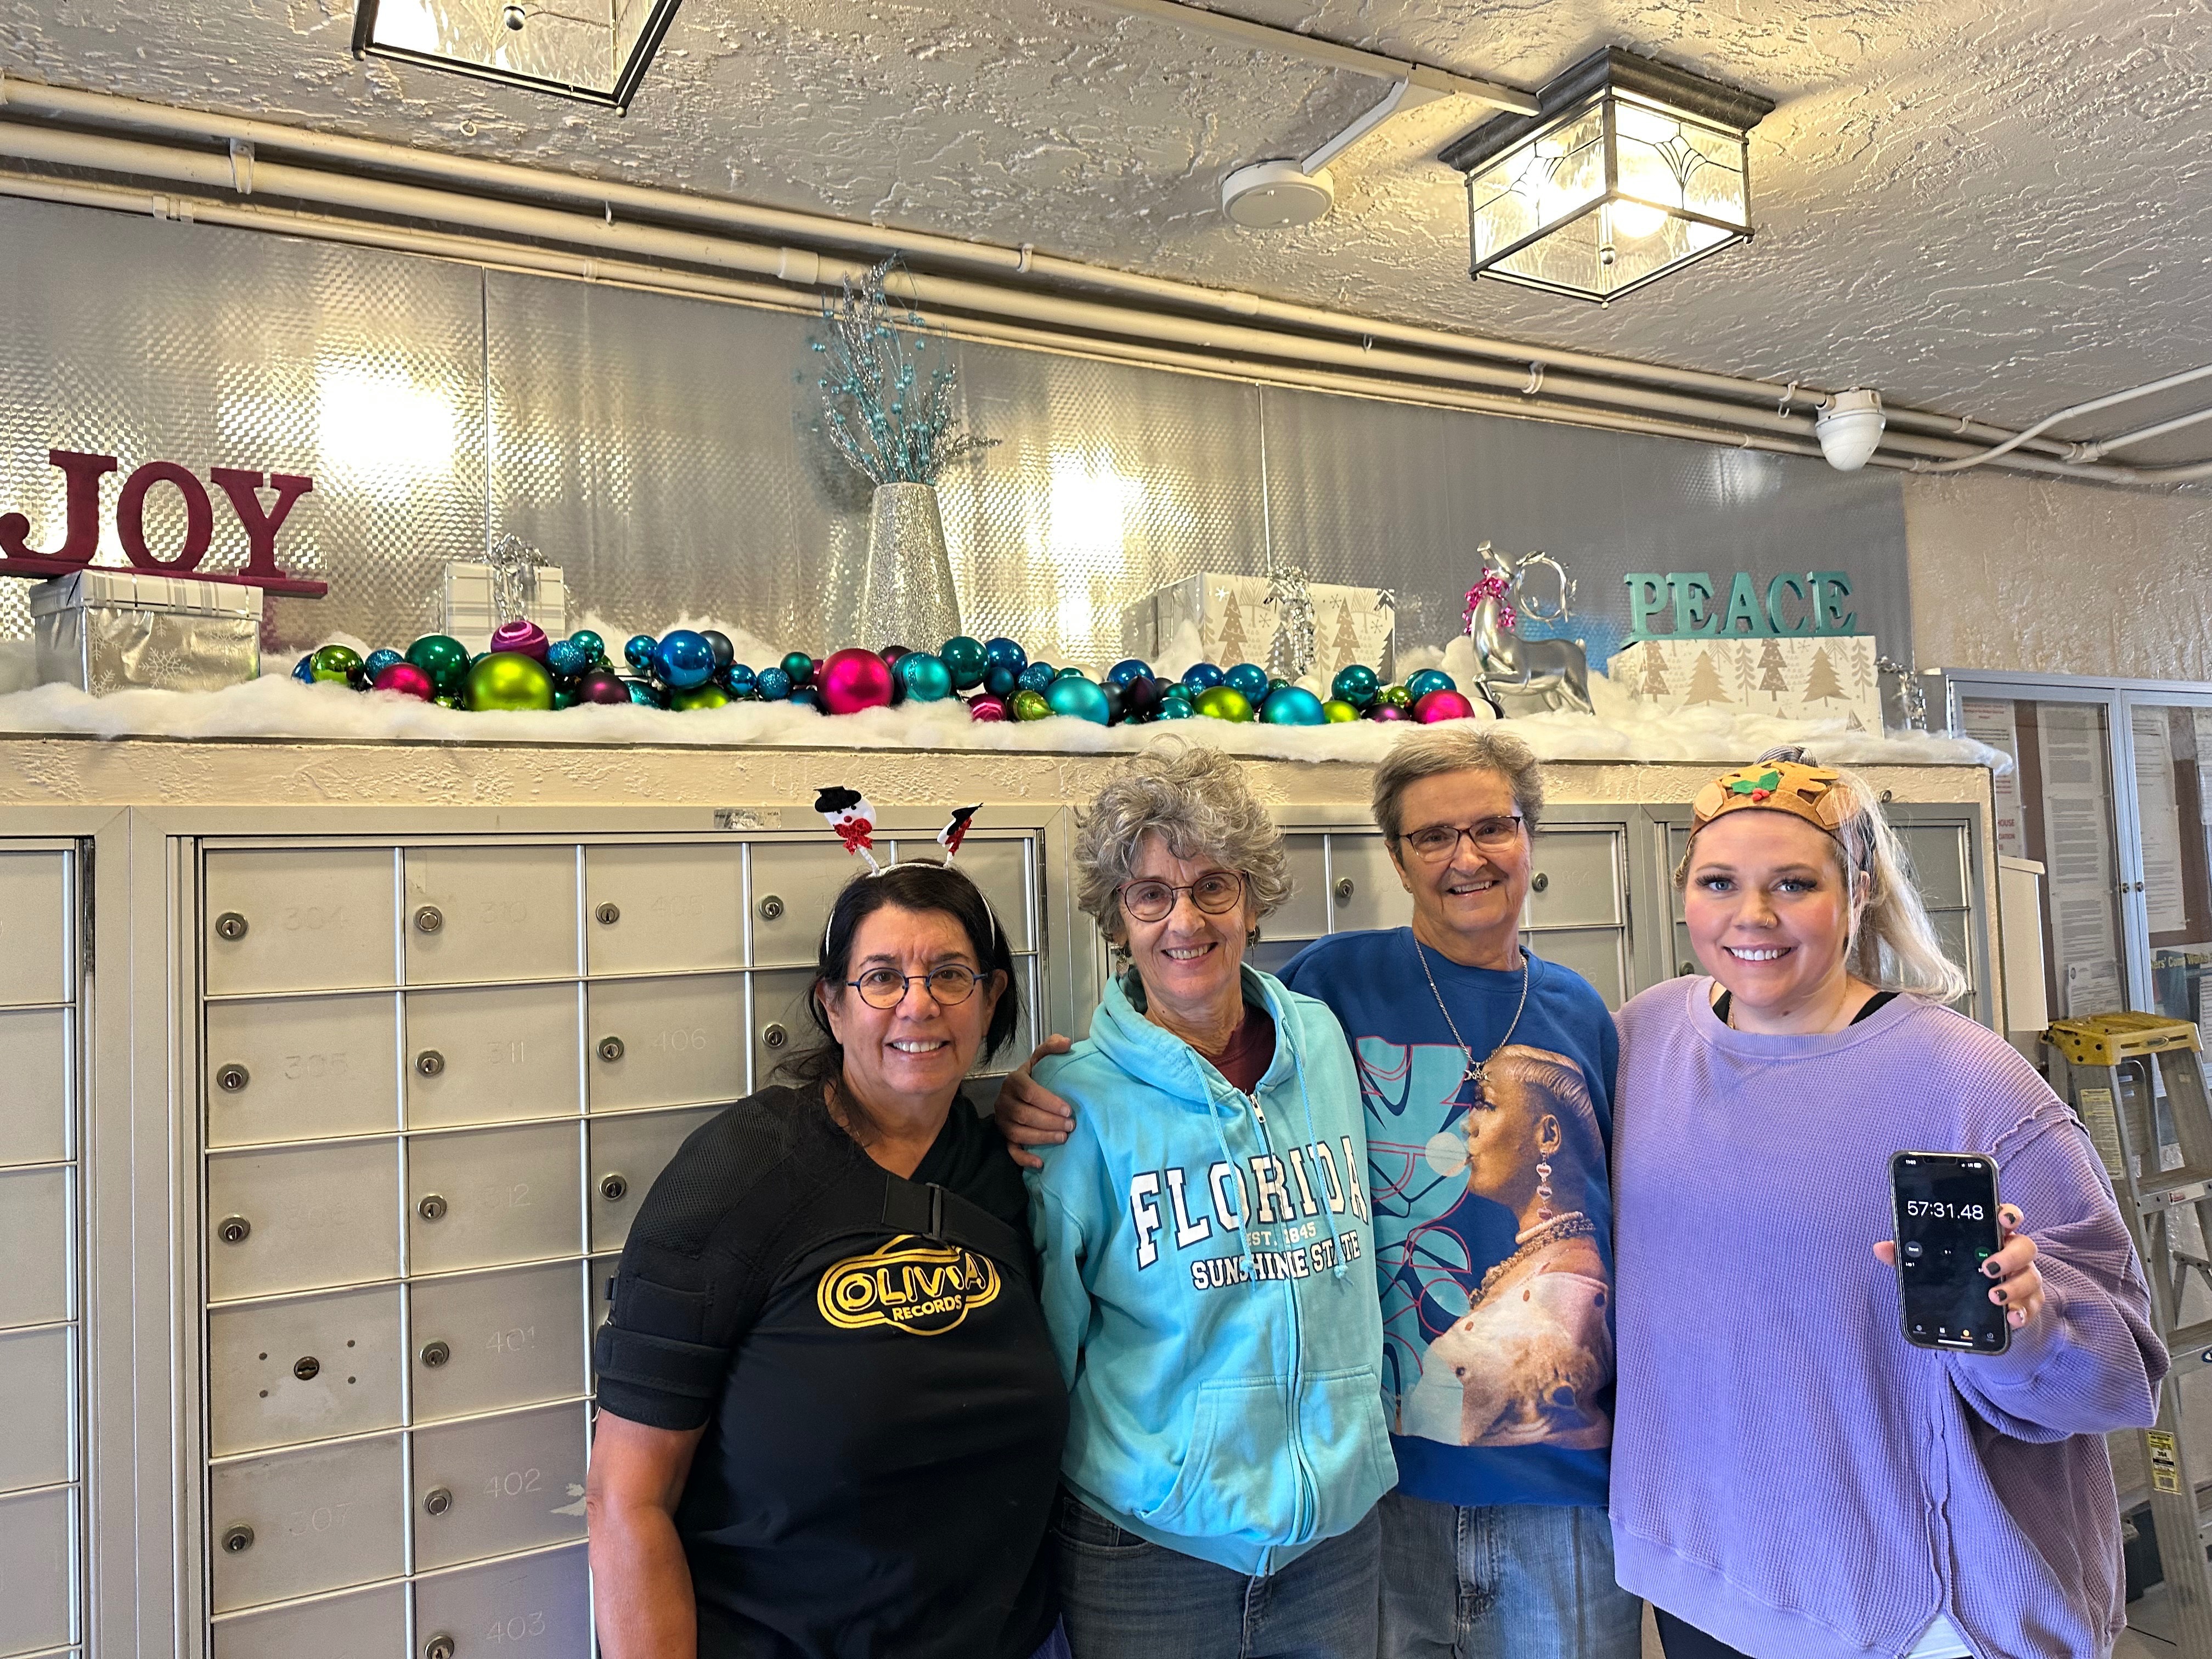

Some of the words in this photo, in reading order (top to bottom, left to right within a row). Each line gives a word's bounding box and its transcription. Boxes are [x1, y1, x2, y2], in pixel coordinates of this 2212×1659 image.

[0, 449, 313, 578] JOY
[1623, 571, 1857, 635] PEACE
[651, 1028, 708, 1052] 406
[284, 1052, 348, 1080] 305
[1130, 1135, 1369, 1272] FLORIDA
[1908, 1201, 1984, 1221] 57:31.48
[1284, 1221, 1317, 1245] 1845
[836, 1252, 986, 1312] OLIVIA
[893, 1294, 962, 1321] RECORDS
[485, 1325, 536, 1353] 401
[483, 1468, 543, 1498] 402
[486, 1611, 546, 1644] 403
